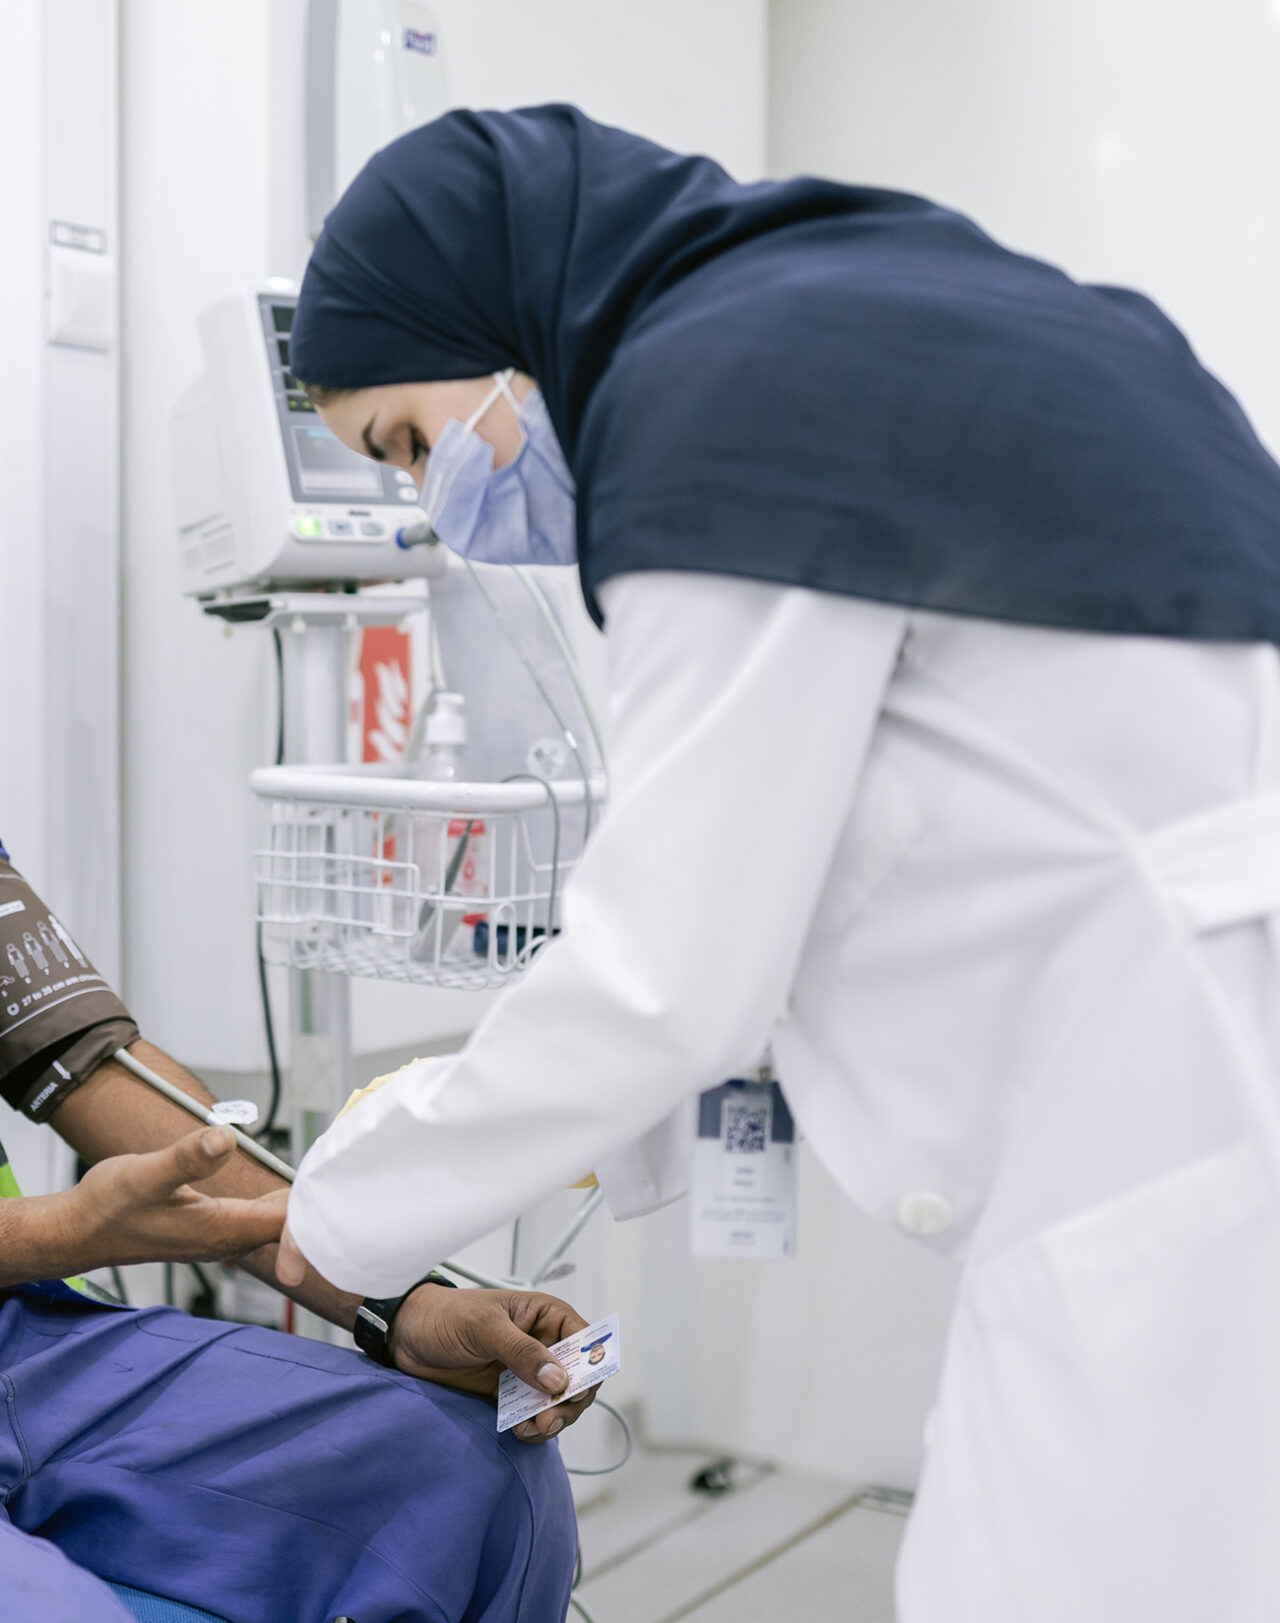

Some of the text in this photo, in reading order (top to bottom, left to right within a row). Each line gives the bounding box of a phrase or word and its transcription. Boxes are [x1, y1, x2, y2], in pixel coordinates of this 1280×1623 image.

[21, 995, 33, 1007] 27
[32, 991, 43, 1001] to
[52, 981, 66, 992] cm
[30, 1081, 59, 1112] ARTERIA
